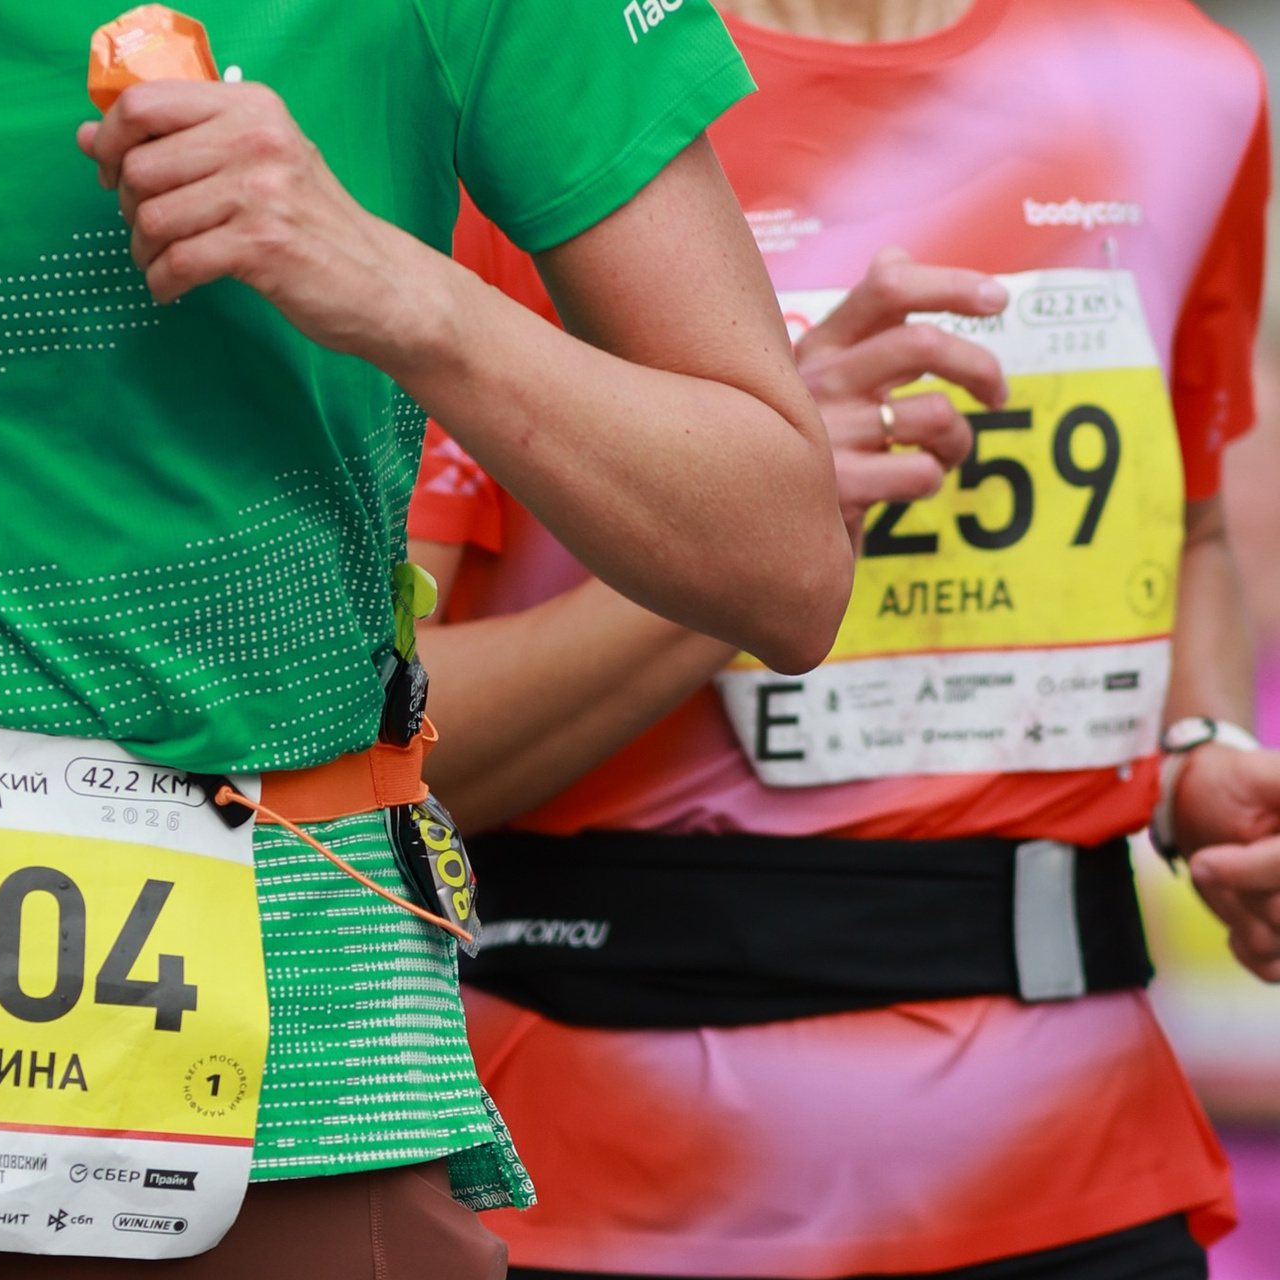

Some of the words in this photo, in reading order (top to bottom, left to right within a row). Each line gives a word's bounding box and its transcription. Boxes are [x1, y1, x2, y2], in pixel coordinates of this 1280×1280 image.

[878, 577, 1014, 617] АЛЕНА
[756, 681, 805, 761] E
[81, 767, 140, 793] 42,2
[151, 773, 191, 797] КМ
[101, 805, 181, 831] 2026
[206, 1073, 221, 1097] 1
[93, 1168, 141, 1183] СБЕР
[149, 1172, 189, 1187] Прайм
[70, 1214, 94, 1225] сбп
[118, 1216, 172, 1230] WINLINE
